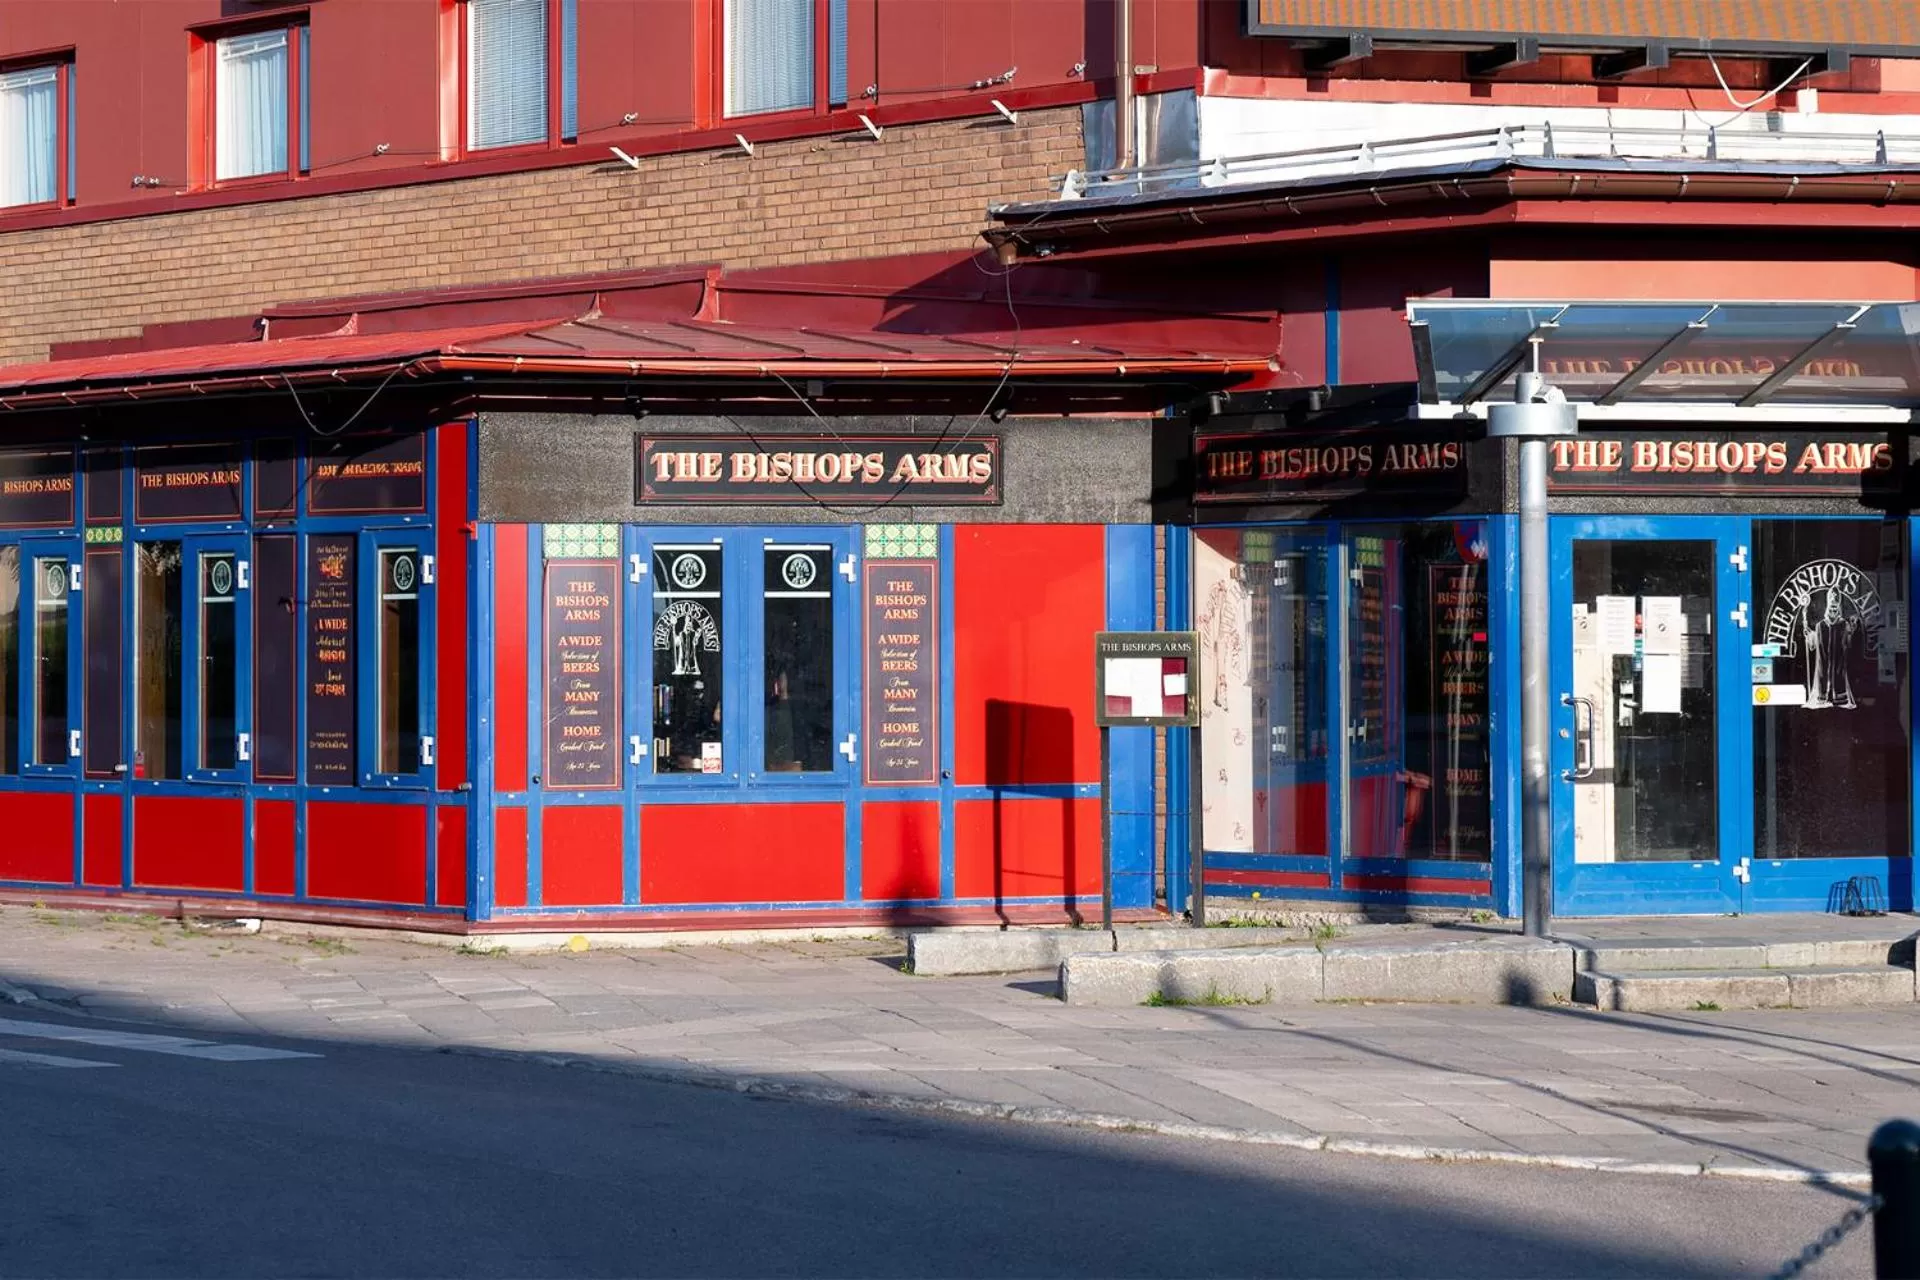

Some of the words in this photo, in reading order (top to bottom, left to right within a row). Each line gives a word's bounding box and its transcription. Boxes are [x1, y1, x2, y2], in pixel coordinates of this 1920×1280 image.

[1207, 451, 1253, 477] THE
[1261, 446, 1373, 478] BISHOPS
[1382, 442, 1459, 471] ARMS
[1551, 440, 1623, 472] THE
[1631, 440, 1787, 473] BISHOPS
[1793, 442, 1893, 473] ARMS
[651, 452, 723, 482] THE
[728, 452, 884, 483] BISHOPS
[888, 452, 992, 484] ARMS
[141, 474, 163, 487] THE
[166, 472, 209, 486] BISHOPS
[210, 470, 240, 484] ARMS
[4, 479, 43, 493] BISHOPS
[44, 478, 72, 491] ARMS
[568, 581, 596, 592] THE
[887, 581, 914, 592] THE
[1780, 563, 1861, 612] BISHOPS
[555, 595, 609, 607] BISHOPS
[875, 594, 927, 606] BISHOPS
[565, 609, 601, 621] ARMS
[884, 609, 919, 620] ARMS
[325, 618, 348, 630] WIDE
[1768, 606, 1794, 649] THE
[558, 636, 568, 646] A
[568, 635, 603, 646] WIDE
[878, 635, 888, 645] A
[888, 634, 921, 645] WIDE
[1101, 643, 1120, 652] THE
[1122, 643, 1162, 652] BISHOPS
[1163, 643, 1192, 652] ARMS
[563, 662, 600, 673] BEERS
[882, 661, 918, 671] BEERS
[564, 691, 600, 702] MANY
[884, 688, 918, 699] MANY
[563, 725, 602, 736] HOME
[883, 722, 920, 733] HOME
